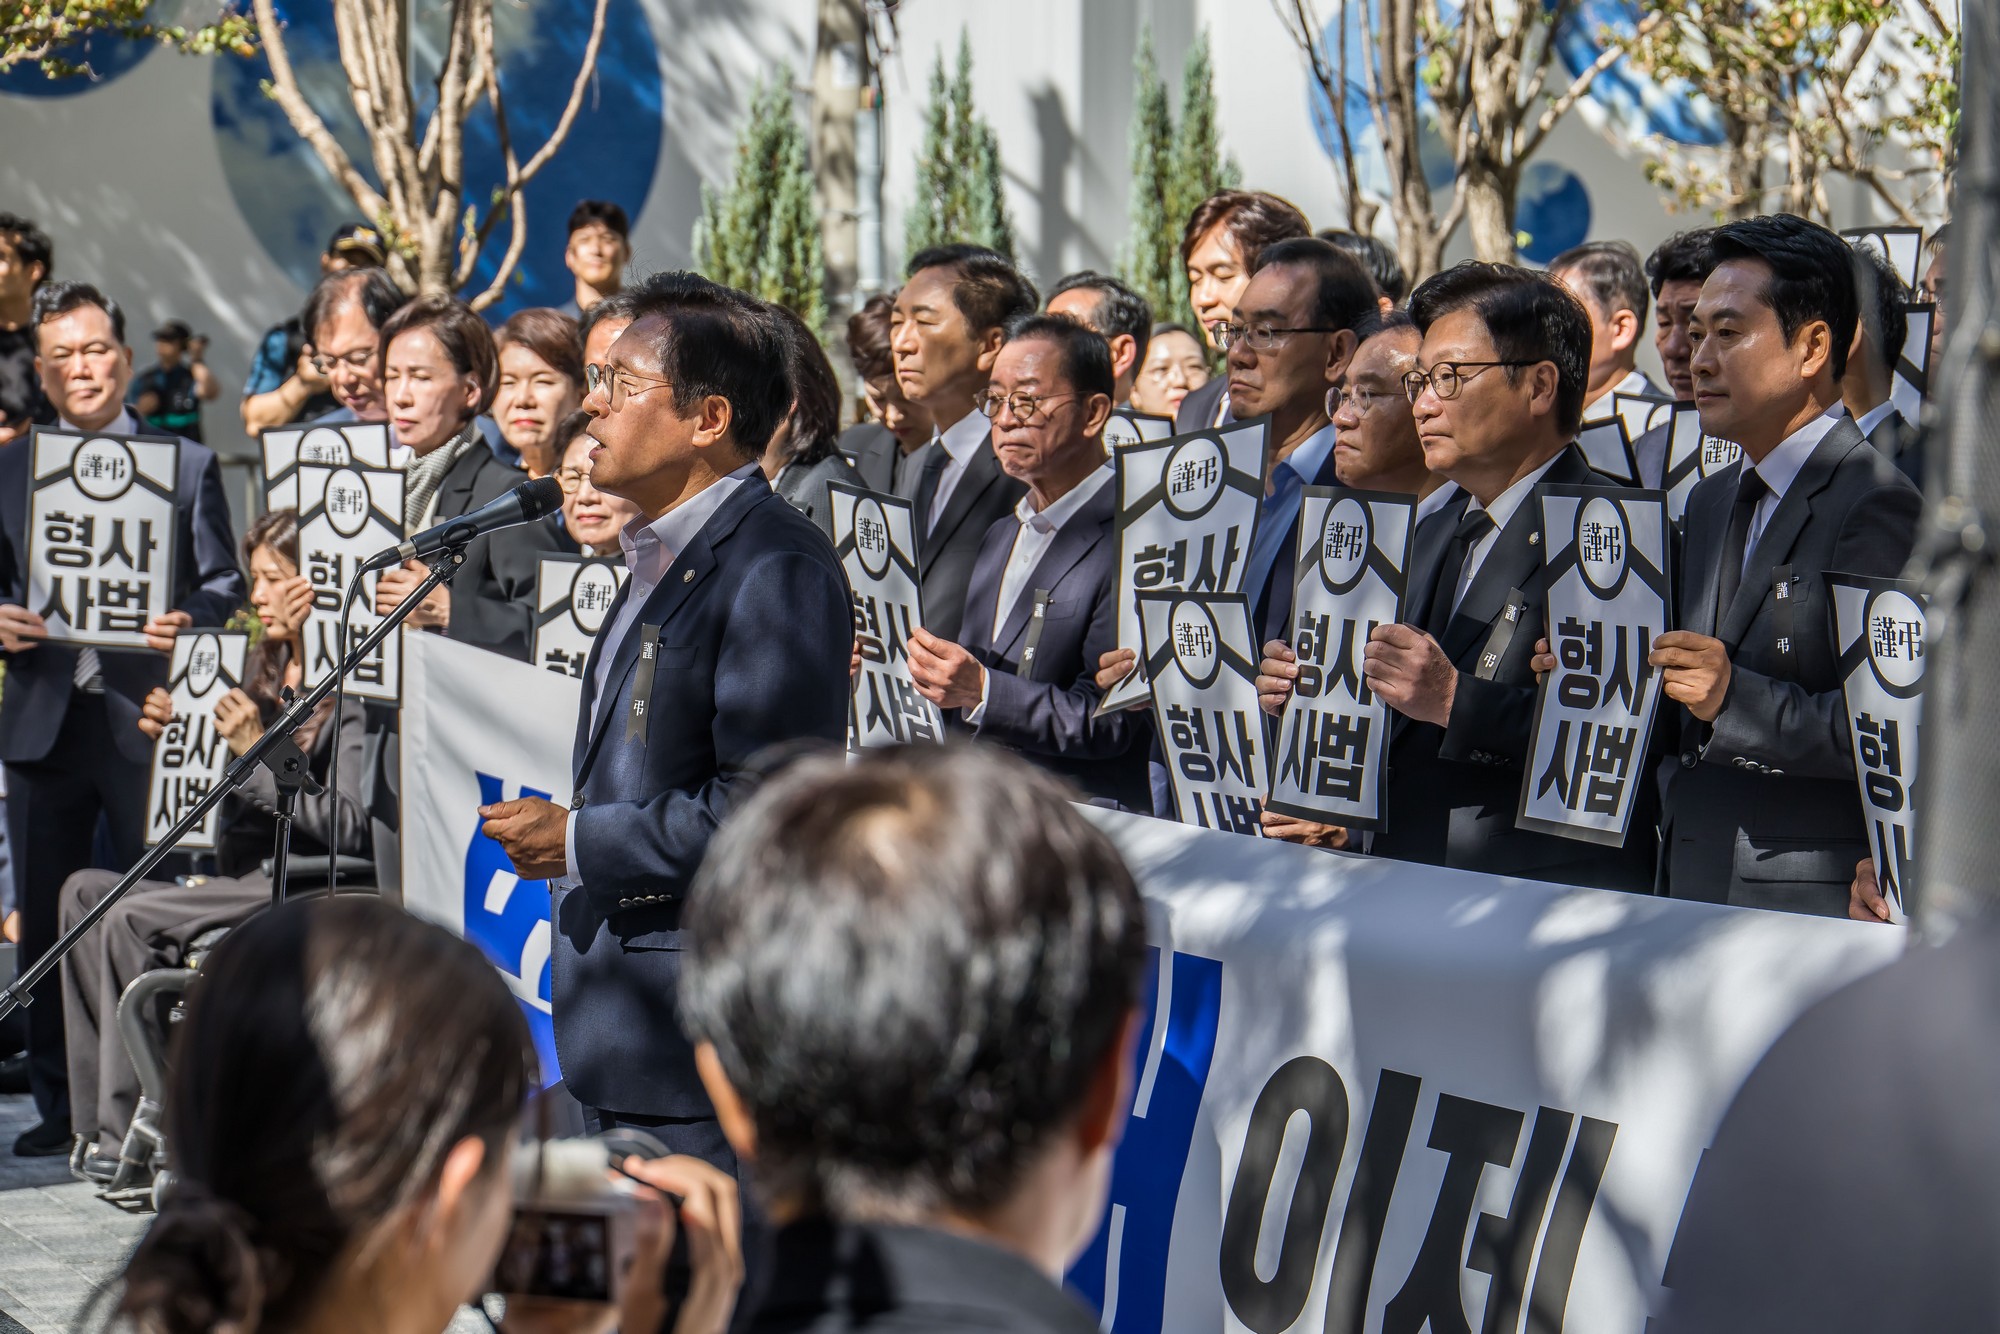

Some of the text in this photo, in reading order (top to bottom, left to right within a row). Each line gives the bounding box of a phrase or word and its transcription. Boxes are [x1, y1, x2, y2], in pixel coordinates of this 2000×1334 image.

[81, 453, 126, 481] 謹弔
[1172, 455, 1218, 496] 謹弔
[331, 486, 363, 515] 謹弔
[44, 510, 158, 573] 형사
[859, 516, 886, 553] 謹弔
[1325, 521, 1364, 562] 謹弔
[1582, 522, 1622, 565] 謹弔
[38, 575, 151, 634] 사법
[577, 581, 612, 611] 謹弔
[1175, 622, 1213, 658] 謹弔
[1295, 610, 1380, 706] 형사
[1873, 615, 1926, 662] 謹弔
[1557, 615, 1655, 717] 형사
[162, 711, 222, 770] 형사
[1166, 703, 1256, 789] 형사
[1280, 708, 1372, 803] 사법
[1537, 719, 1639, 817] 사법
[1219, 1055, 1619, 1334] 이제
